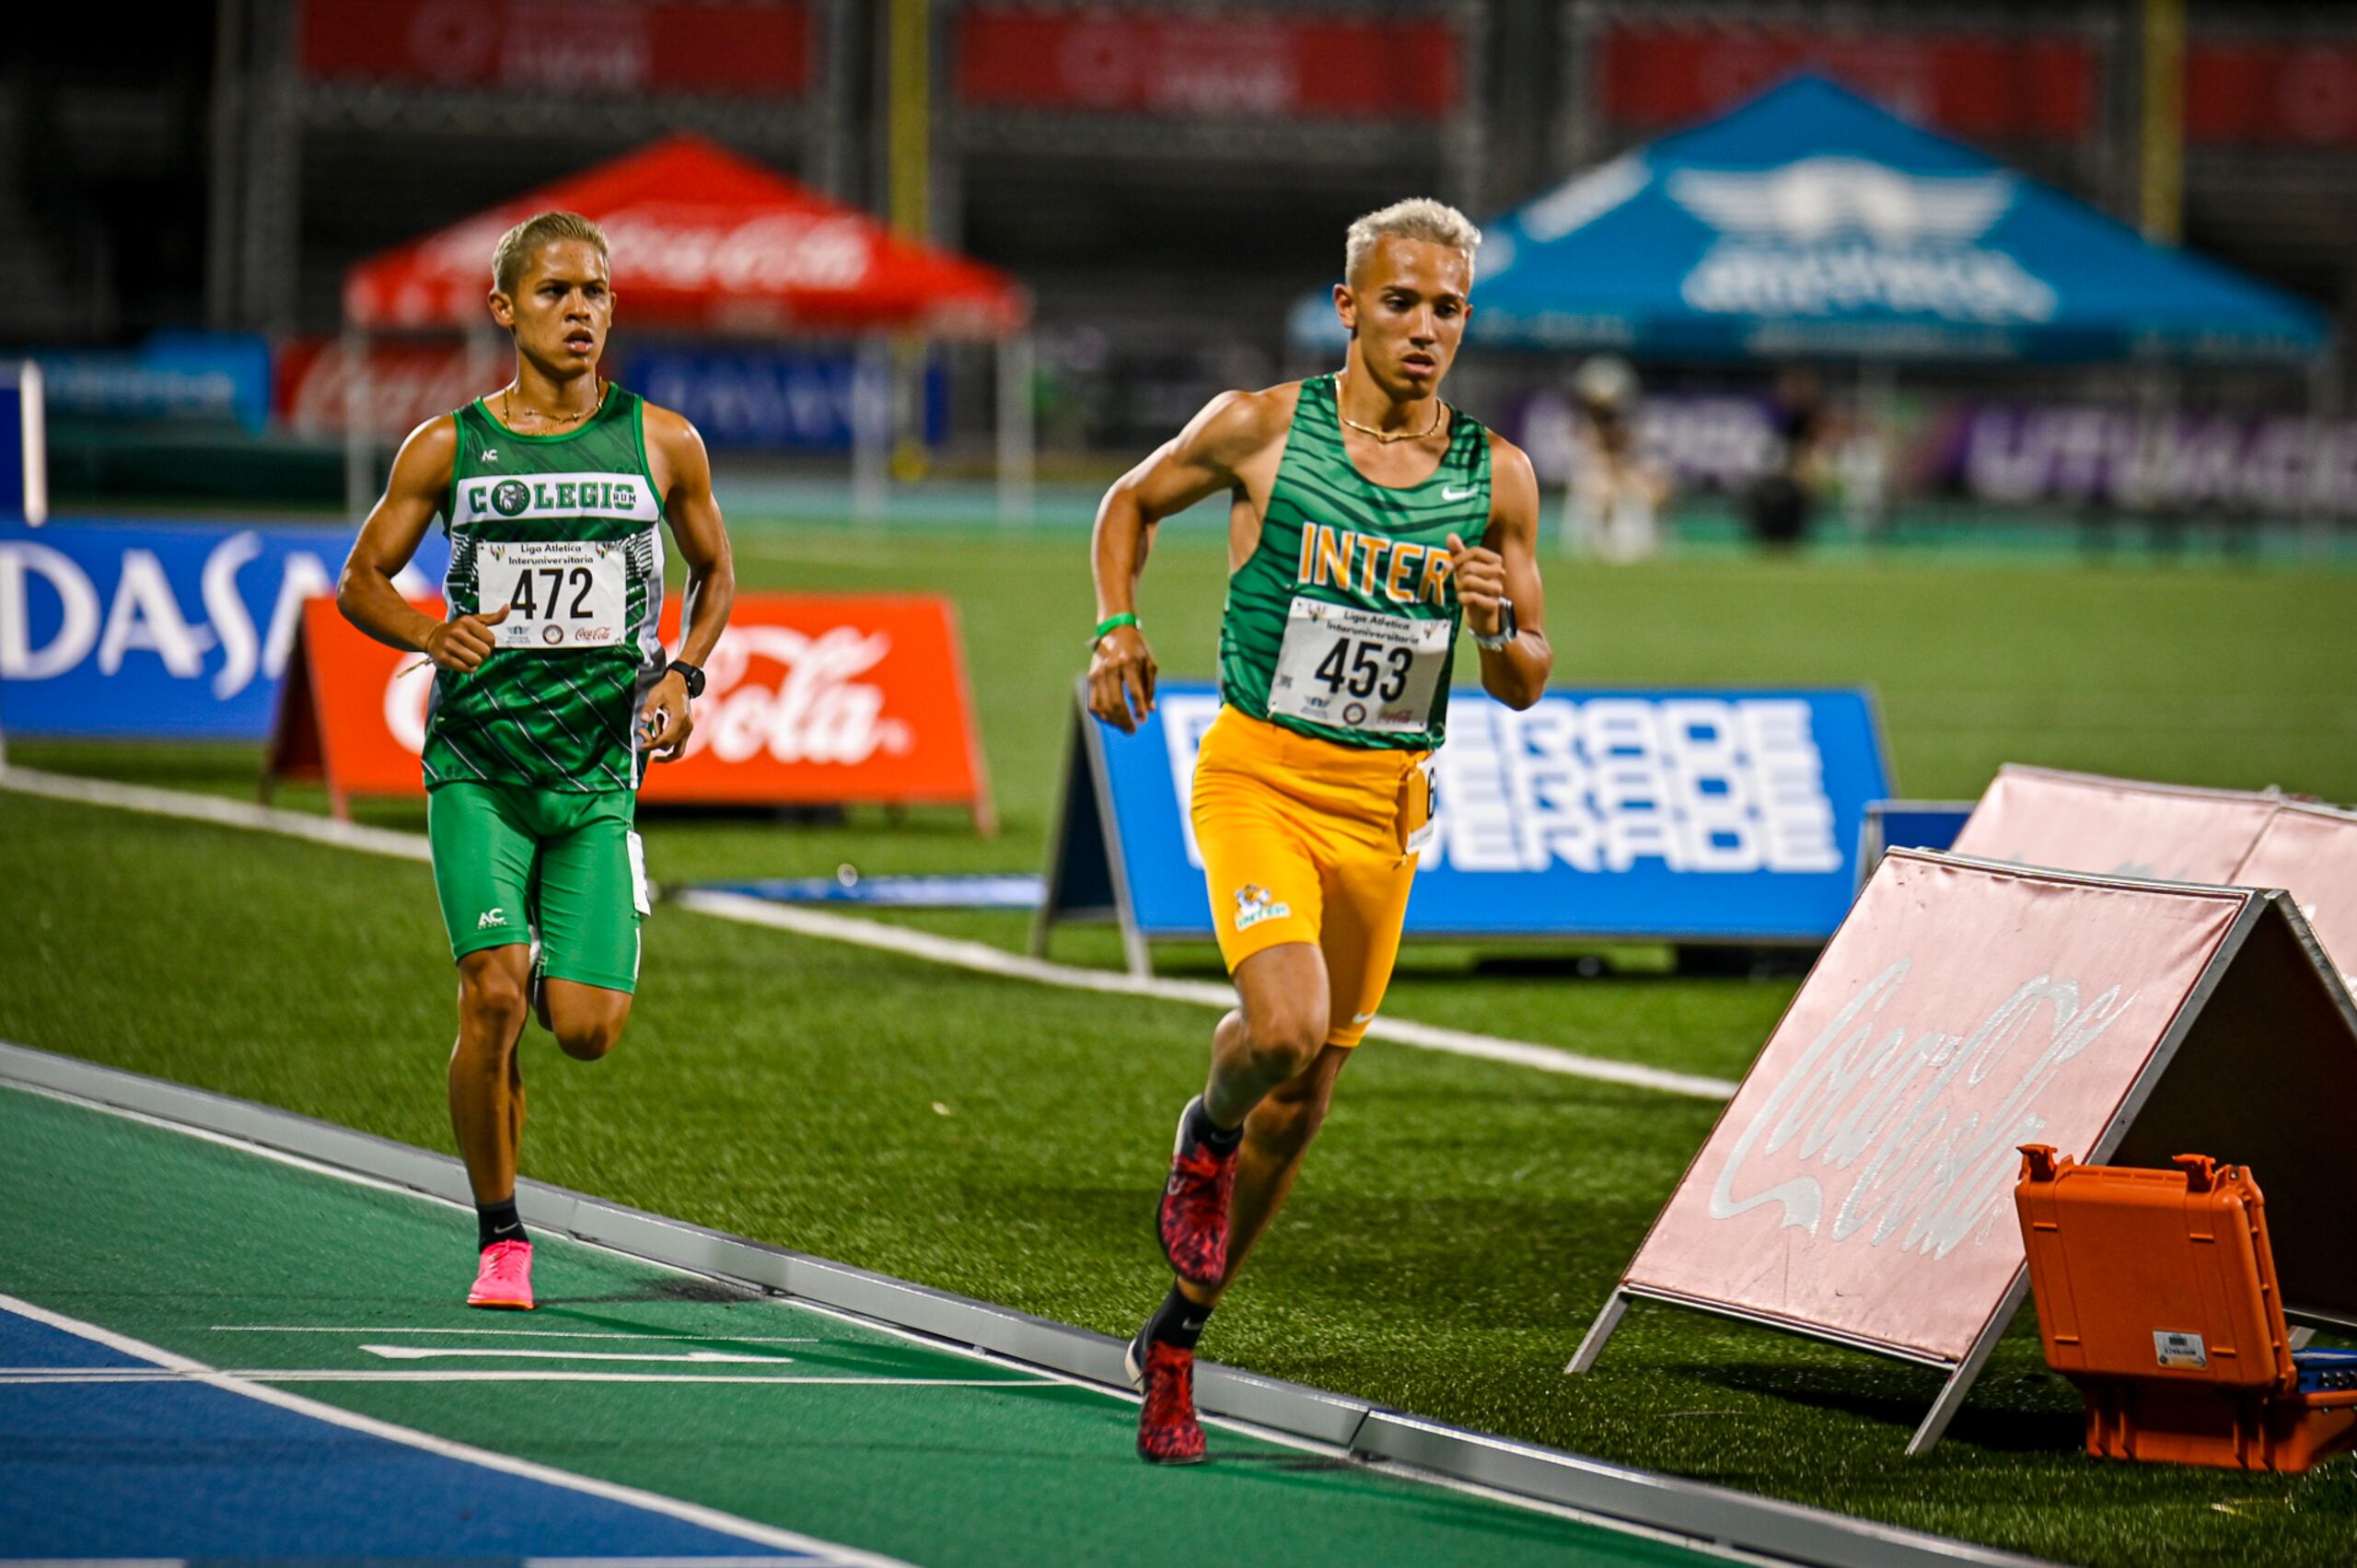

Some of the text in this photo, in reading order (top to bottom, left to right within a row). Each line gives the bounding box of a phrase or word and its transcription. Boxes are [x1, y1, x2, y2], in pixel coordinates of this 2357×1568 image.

[520, 544, 542, 554] Liga
[1297, 521, 1454, 606] INTER
[510, 567, 594, 621] 472
[1343, 611, 1368, 624] Liga
[1314, 637, 1413, 703] 453
[478, 908, 505, 923] AC
